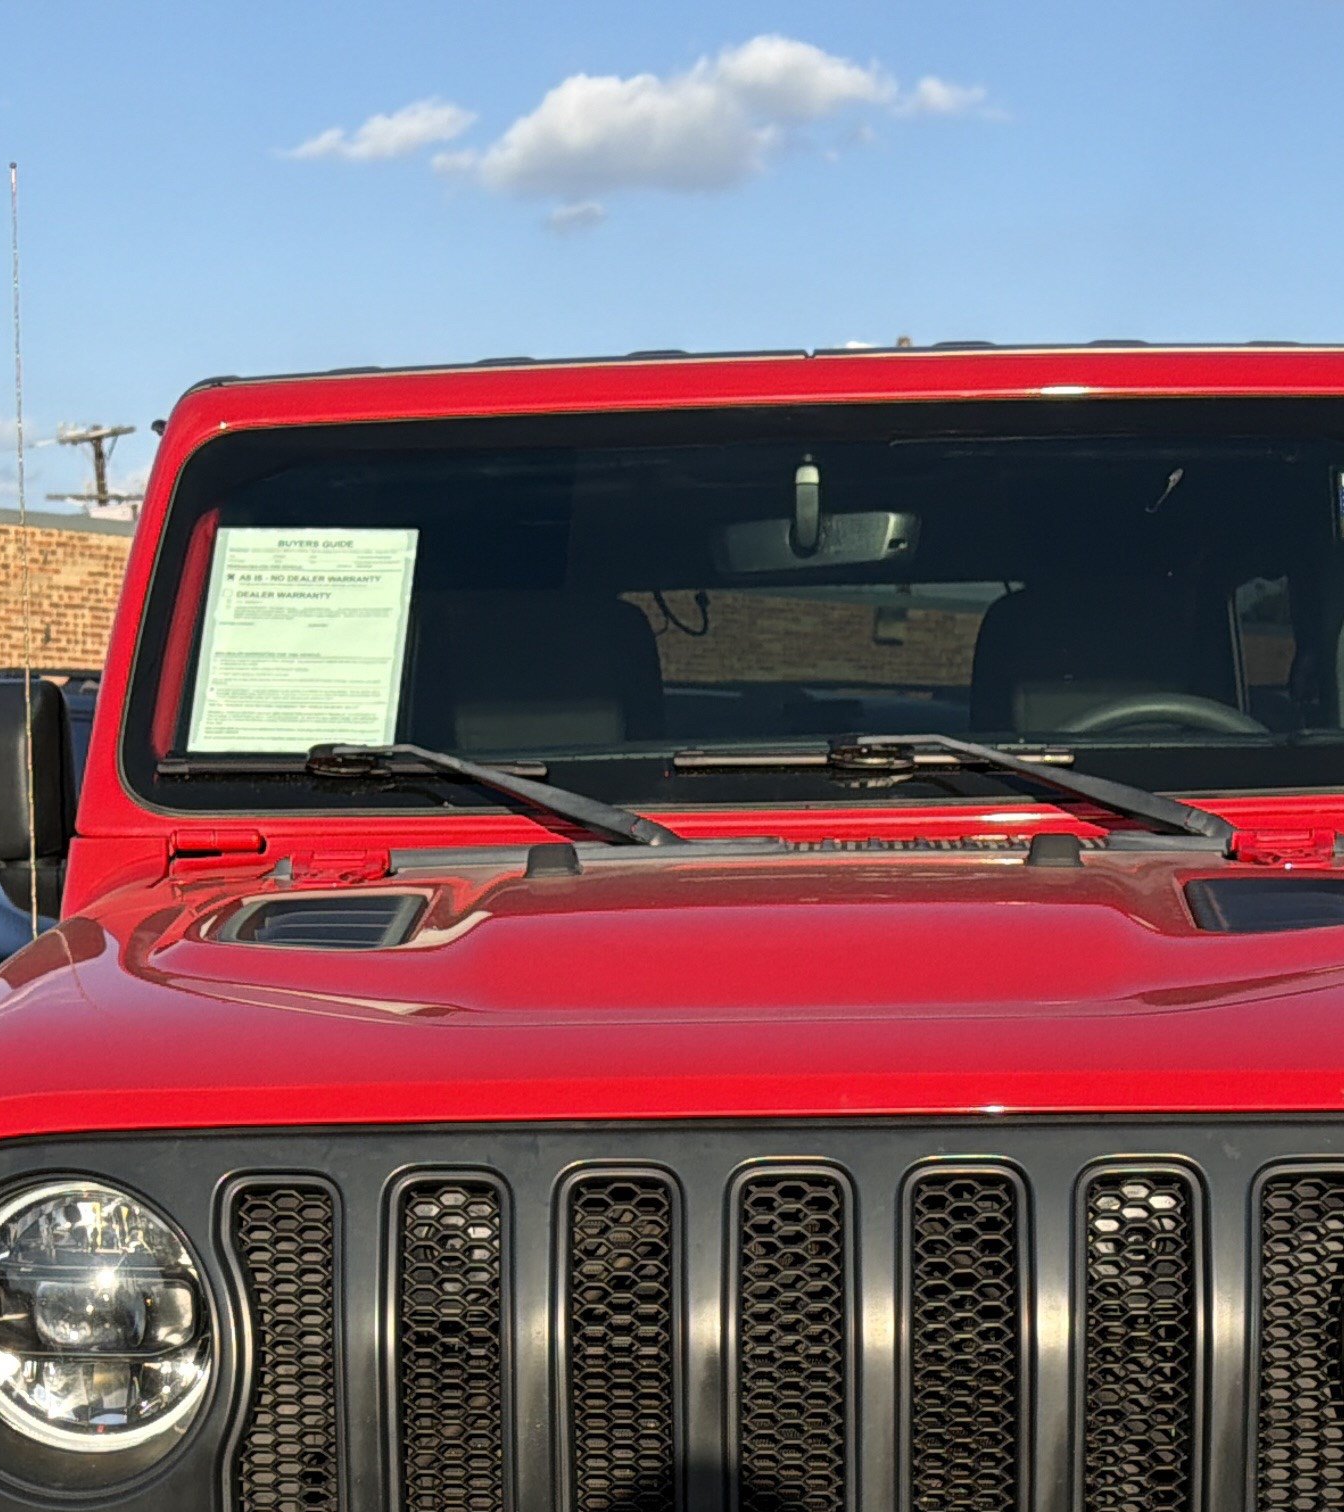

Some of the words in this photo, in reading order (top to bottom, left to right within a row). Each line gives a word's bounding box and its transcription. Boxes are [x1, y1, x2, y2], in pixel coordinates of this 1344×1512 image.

[277, 540, 319, 548] BUYERS
[322, 540, 354, 548] GUIDE
[239, 574, 252, 582] AS
[270, 574, 285, 582] NO
